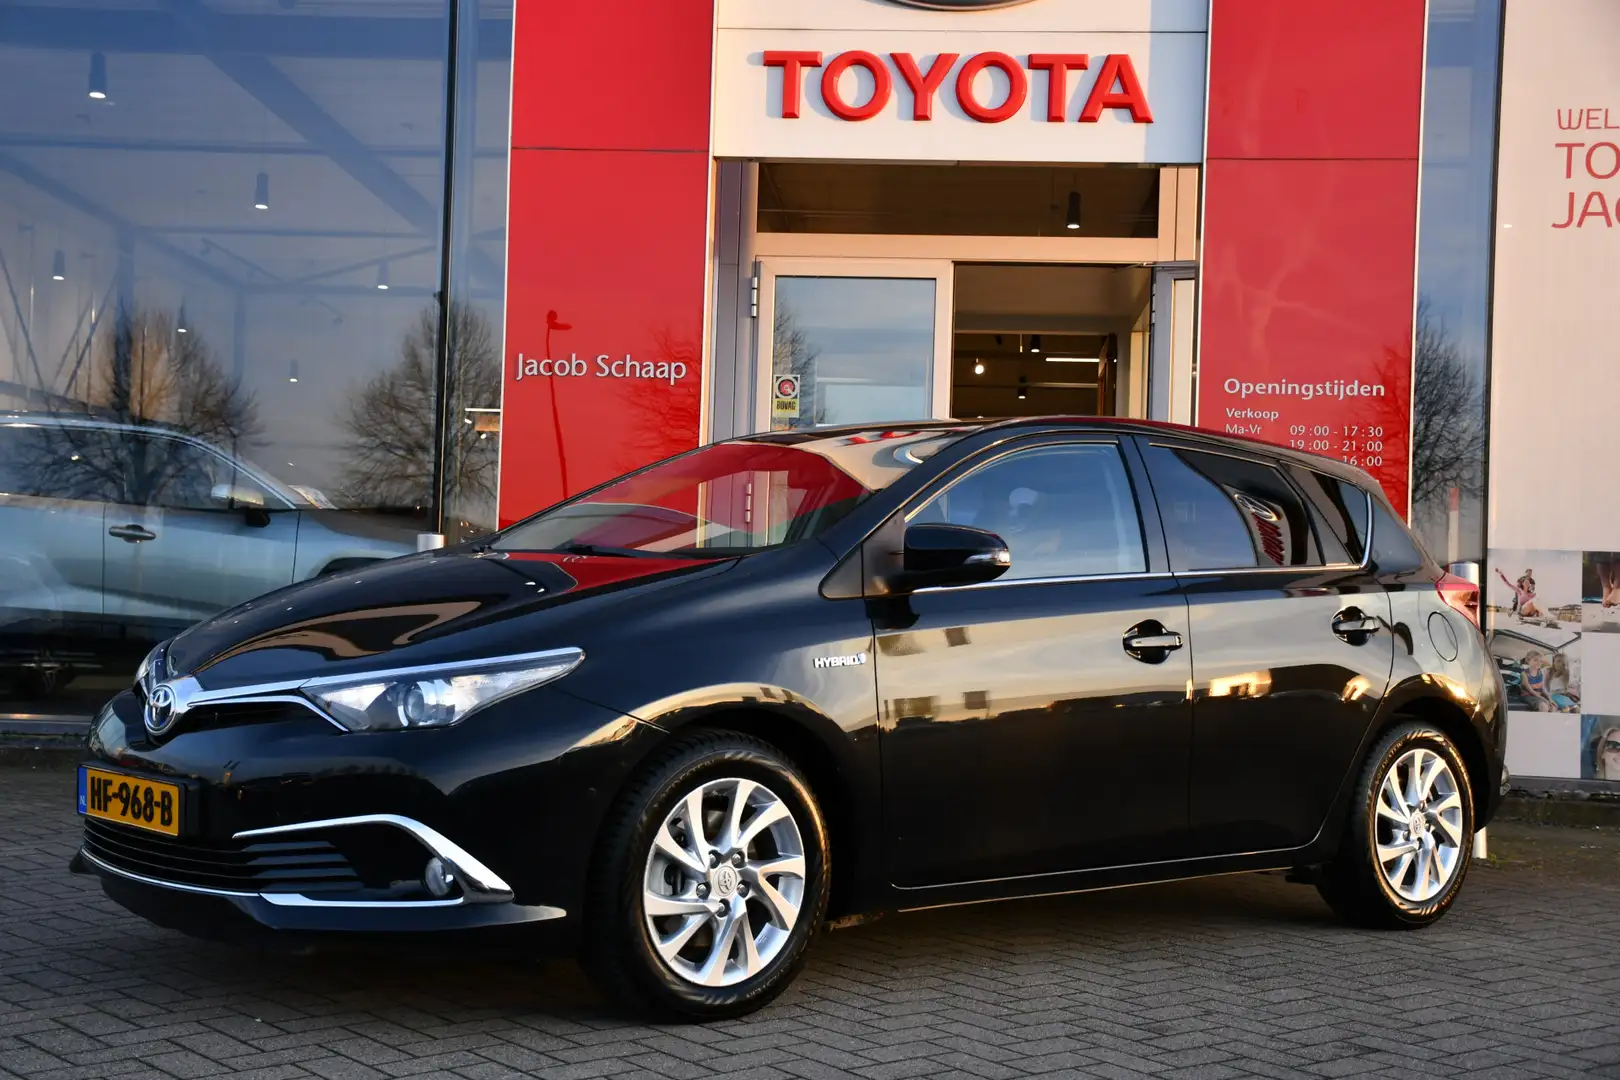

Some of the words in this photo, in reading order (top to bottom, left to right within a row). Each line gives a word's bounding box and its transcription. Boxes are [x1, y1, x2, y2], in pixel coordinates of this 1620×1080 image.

[763, 50, 1153, 123] TOYOTA
[1555, 142, 1620, 180] TO
[1551, 191, 1620, 229] JA
[516, 353, 588, 381] Jacob
[595, 354, 687, 385] Schaap
[1223, 378, 1386, 400] Openingstijden
[776, 400, 796, 411] BOVAG
[1225, 407, 1279, 420] Verkoop
[1225, 423, 1262, 435] Ma-Vr
[813, 655, 860, 668] HYBRID
[90, 776, 173, 827] HF-968-B
